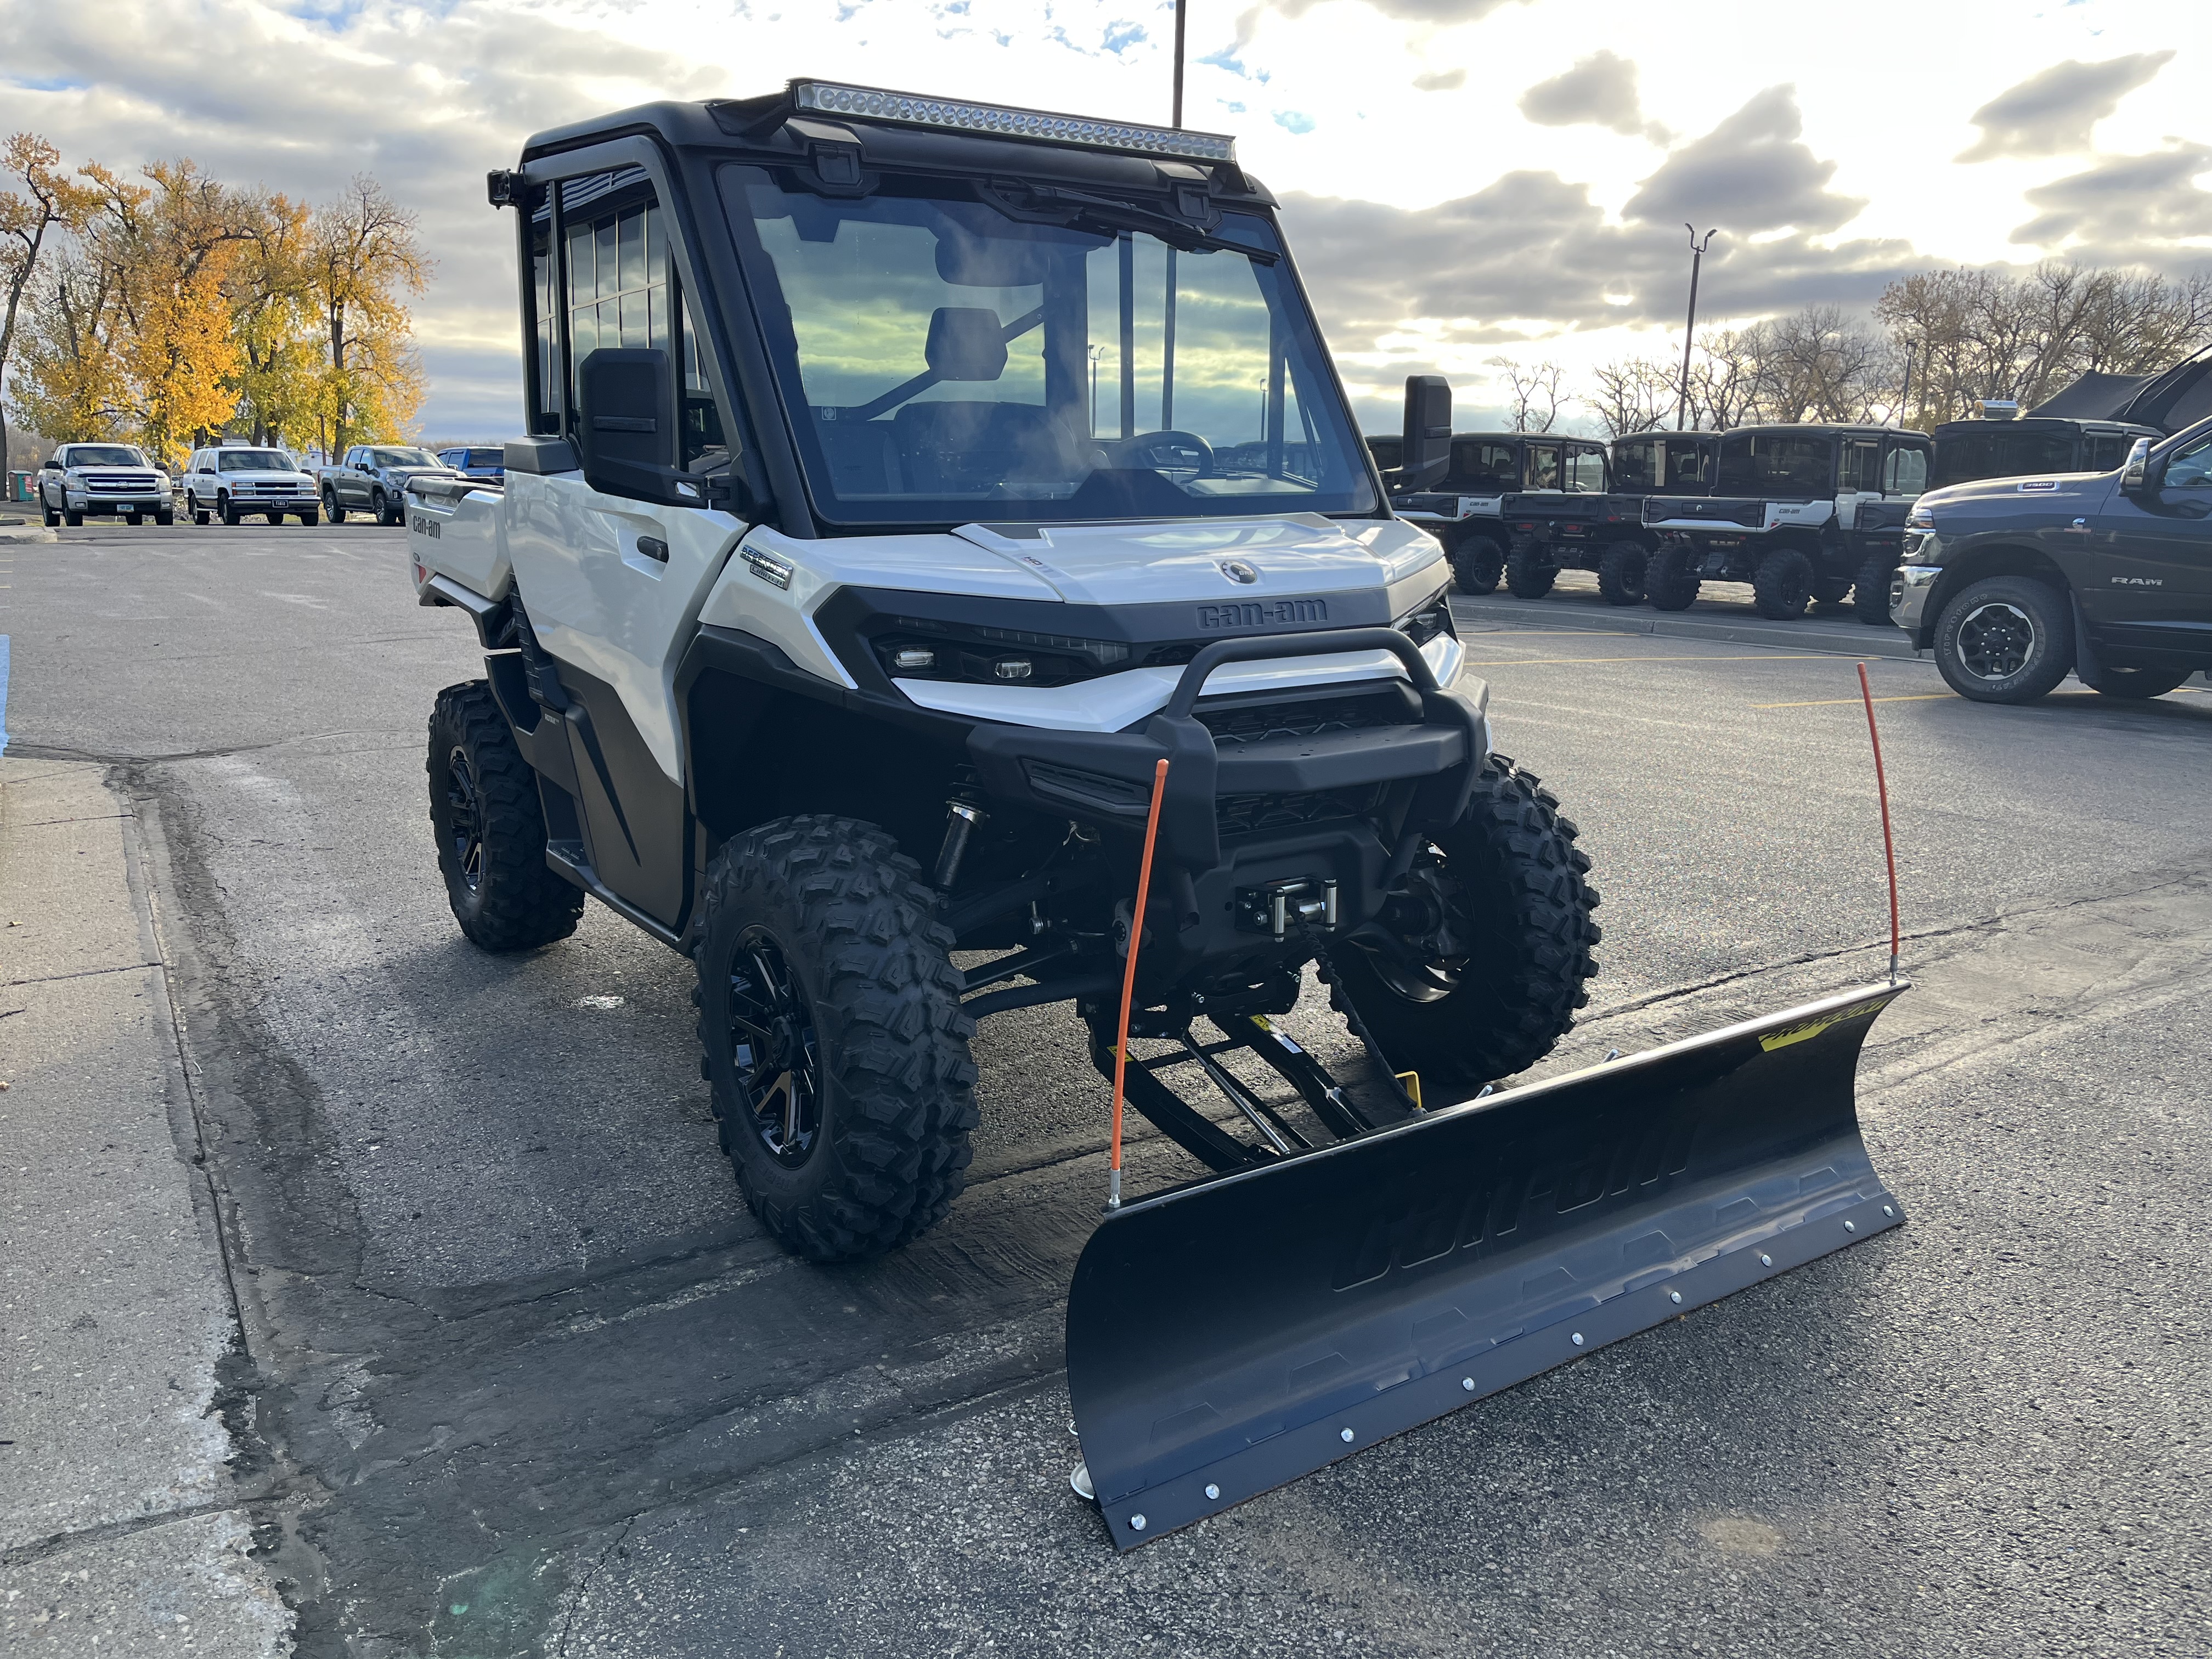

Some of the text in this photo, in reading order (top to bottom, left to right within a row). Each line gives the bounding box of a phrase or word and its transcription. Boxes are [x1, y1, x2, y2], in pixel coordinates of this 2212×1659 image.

[413, 515, 441, 540] can-am
[2111, 577, 2163, 586] RAM
[1197, 599, 1328, 630] can-am
